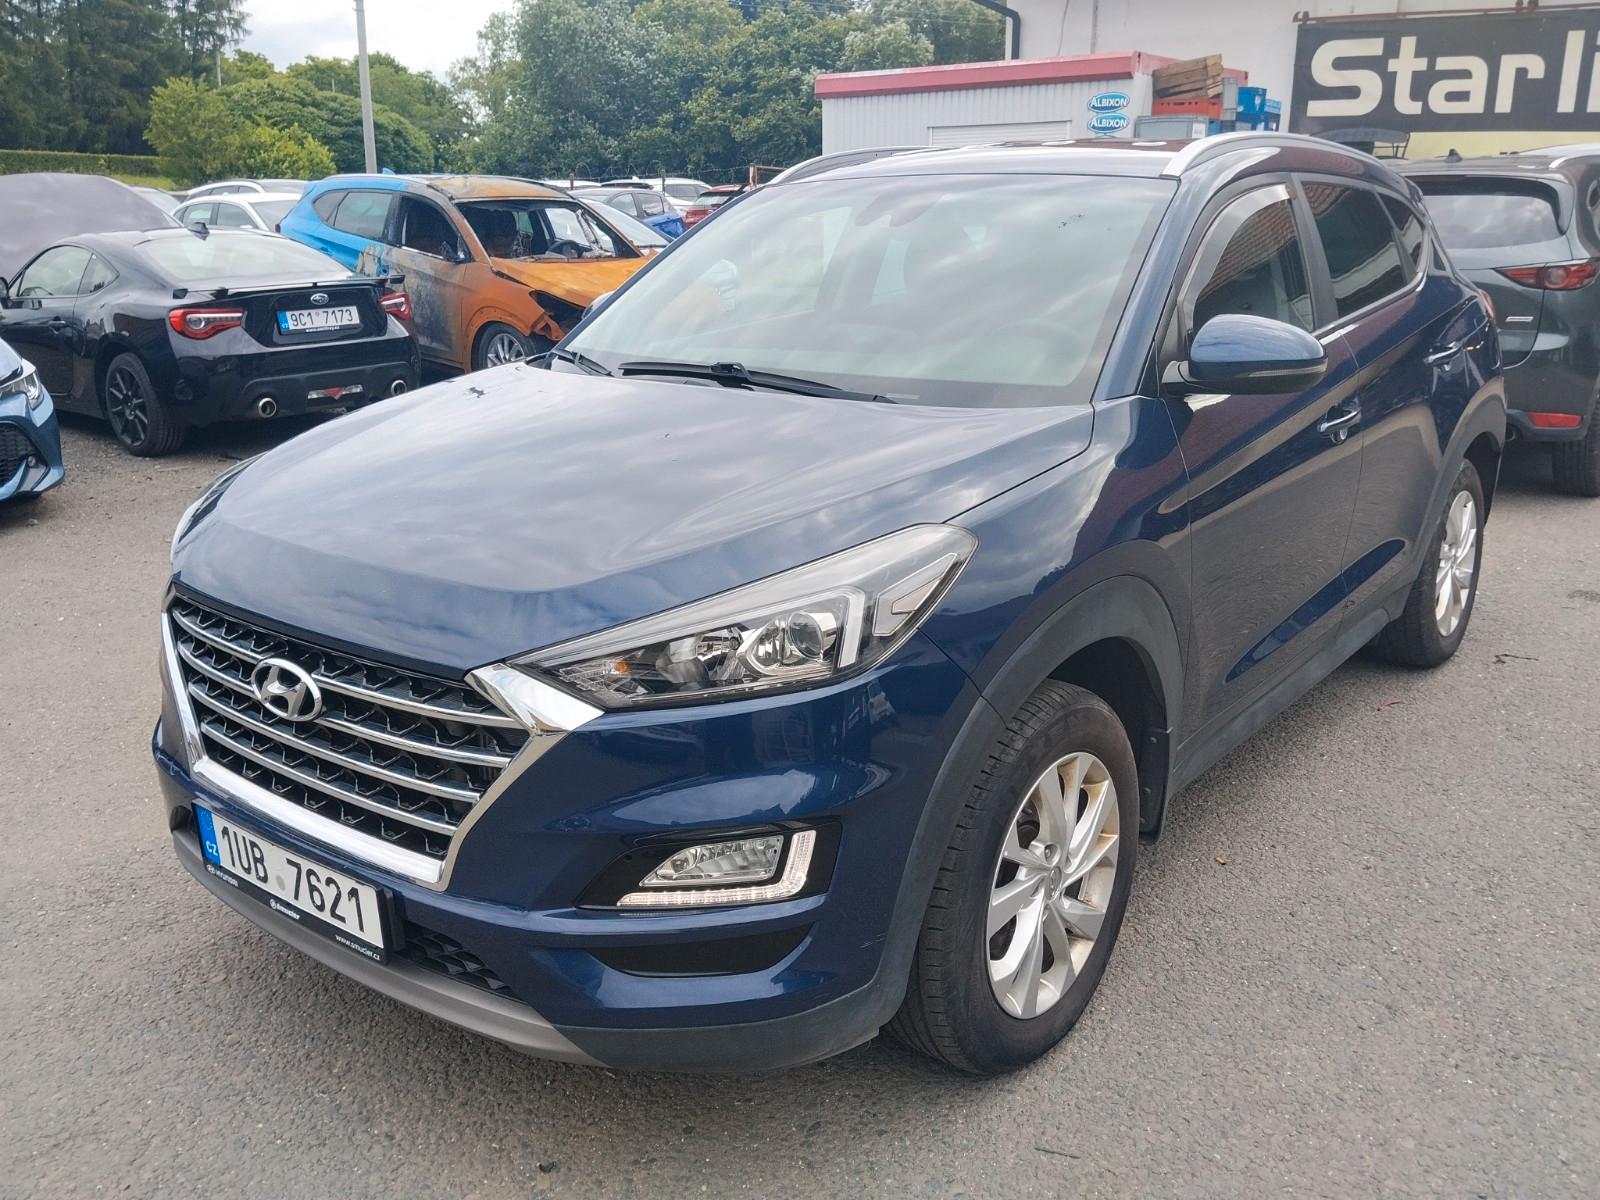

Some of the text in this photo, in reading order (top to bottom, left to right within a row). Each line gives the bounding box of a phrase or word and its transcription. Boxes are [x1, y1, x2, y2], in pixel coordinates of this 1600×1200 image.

[1091, 96, 1127, 107] ALBIXON
[1091, 117, 1127, 128] ALBIXON
[290, 309, 353, 327] 9C1 7173
[206, 840, 219, 857] CZ
[221, 825, 365, 933] 1UB 7621
